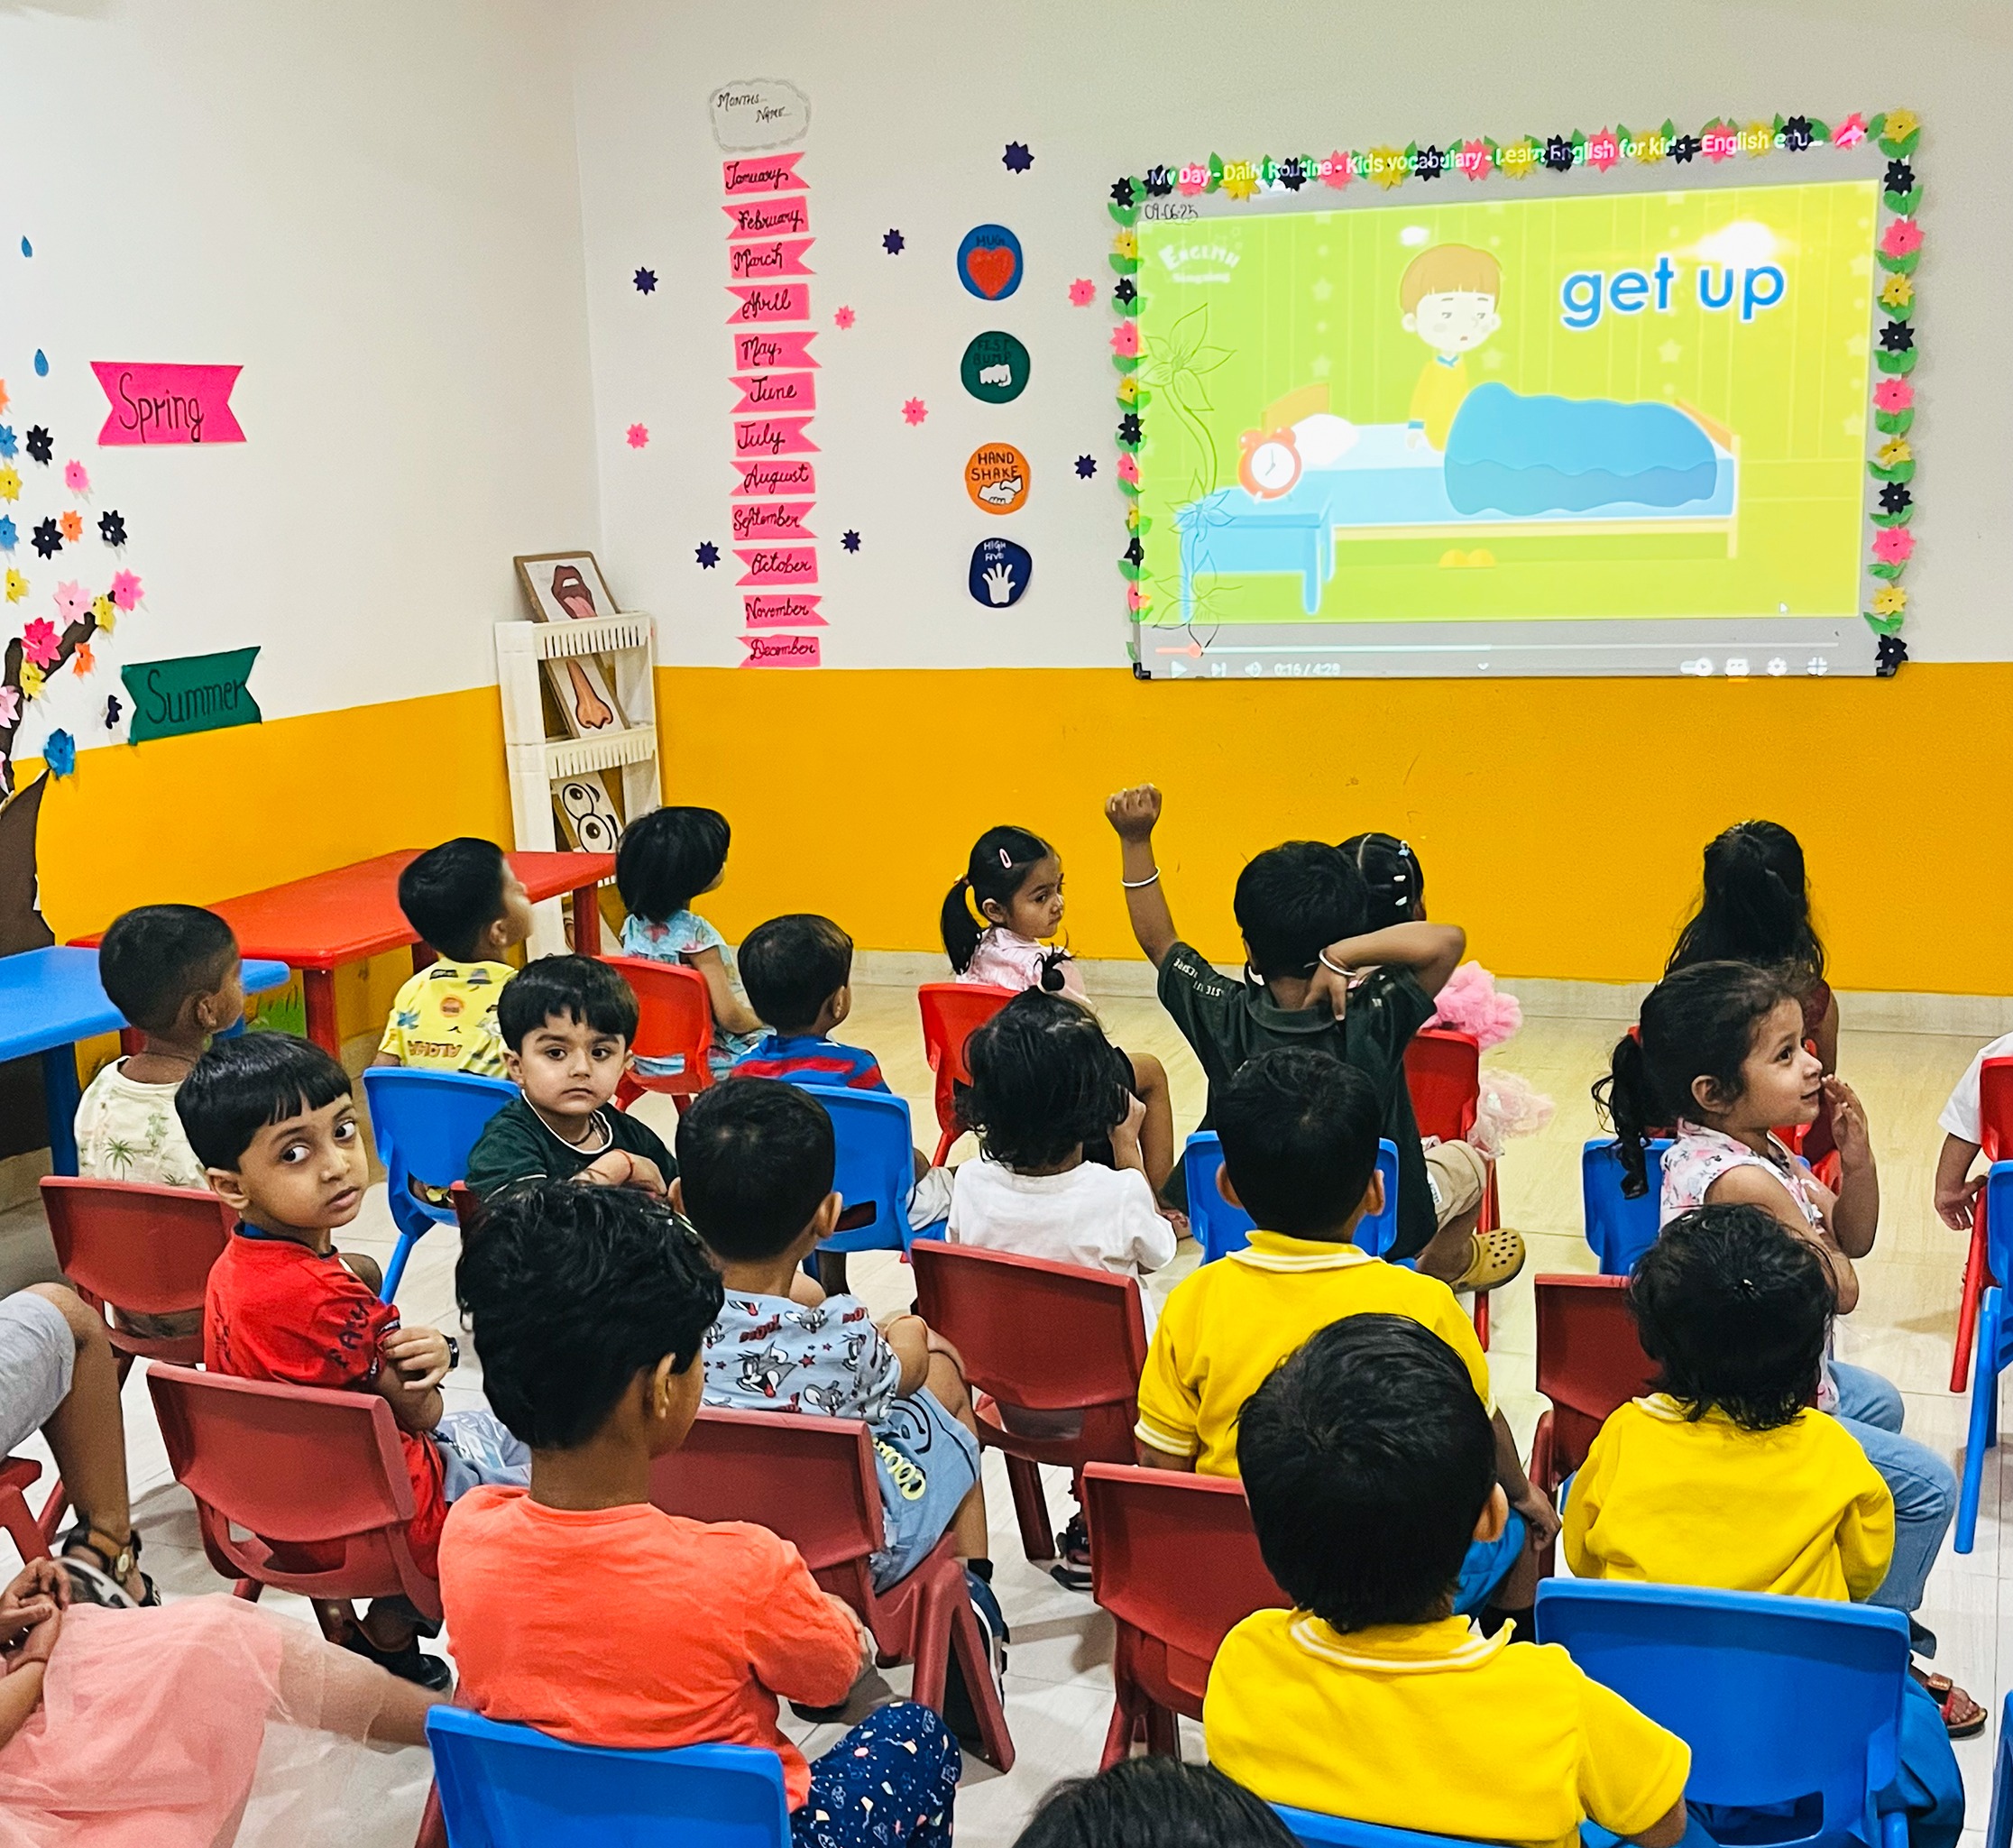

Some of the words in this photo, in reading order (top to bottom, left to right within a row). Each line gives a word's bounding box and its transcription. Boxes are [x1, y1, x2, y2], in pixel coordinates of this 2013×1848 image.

[1151, 169, 1177, 186] My
[1179, 167, 1211, 188] Day
[1223, 161, 1264, 181] Daily
[1346, 156, 1384, 175] Kids
[1387, 150, 1482, 171] vocabulary
[1495, 147, 1546, 166] Learn
[1549, 139, 1614, 165] English
[1619, 137, 1646, 158] for
[1701, 131, 1769, 156] English
[725, 161, 789, 190] January
[738, 208, 804, 232] February
[976, 234, 1005, 246] HUG
[733, 242, 783, 278] March
[1561, 256, 1675, 328] get
[1699, 265, 1785, 320] up
[749, 375, 797, 402] June
[118, 372, 205, 444] Spring
[737, 422, 786, 455] July
[977, 451, 1015, 464] HAND
[743, 463, 810, 494] August
[970, 464, 1019, 482] SHAKE
[751, 551, 812, 576] October
[745, 596, 810, 621] November
[145, 668, 245, 725] Summer
